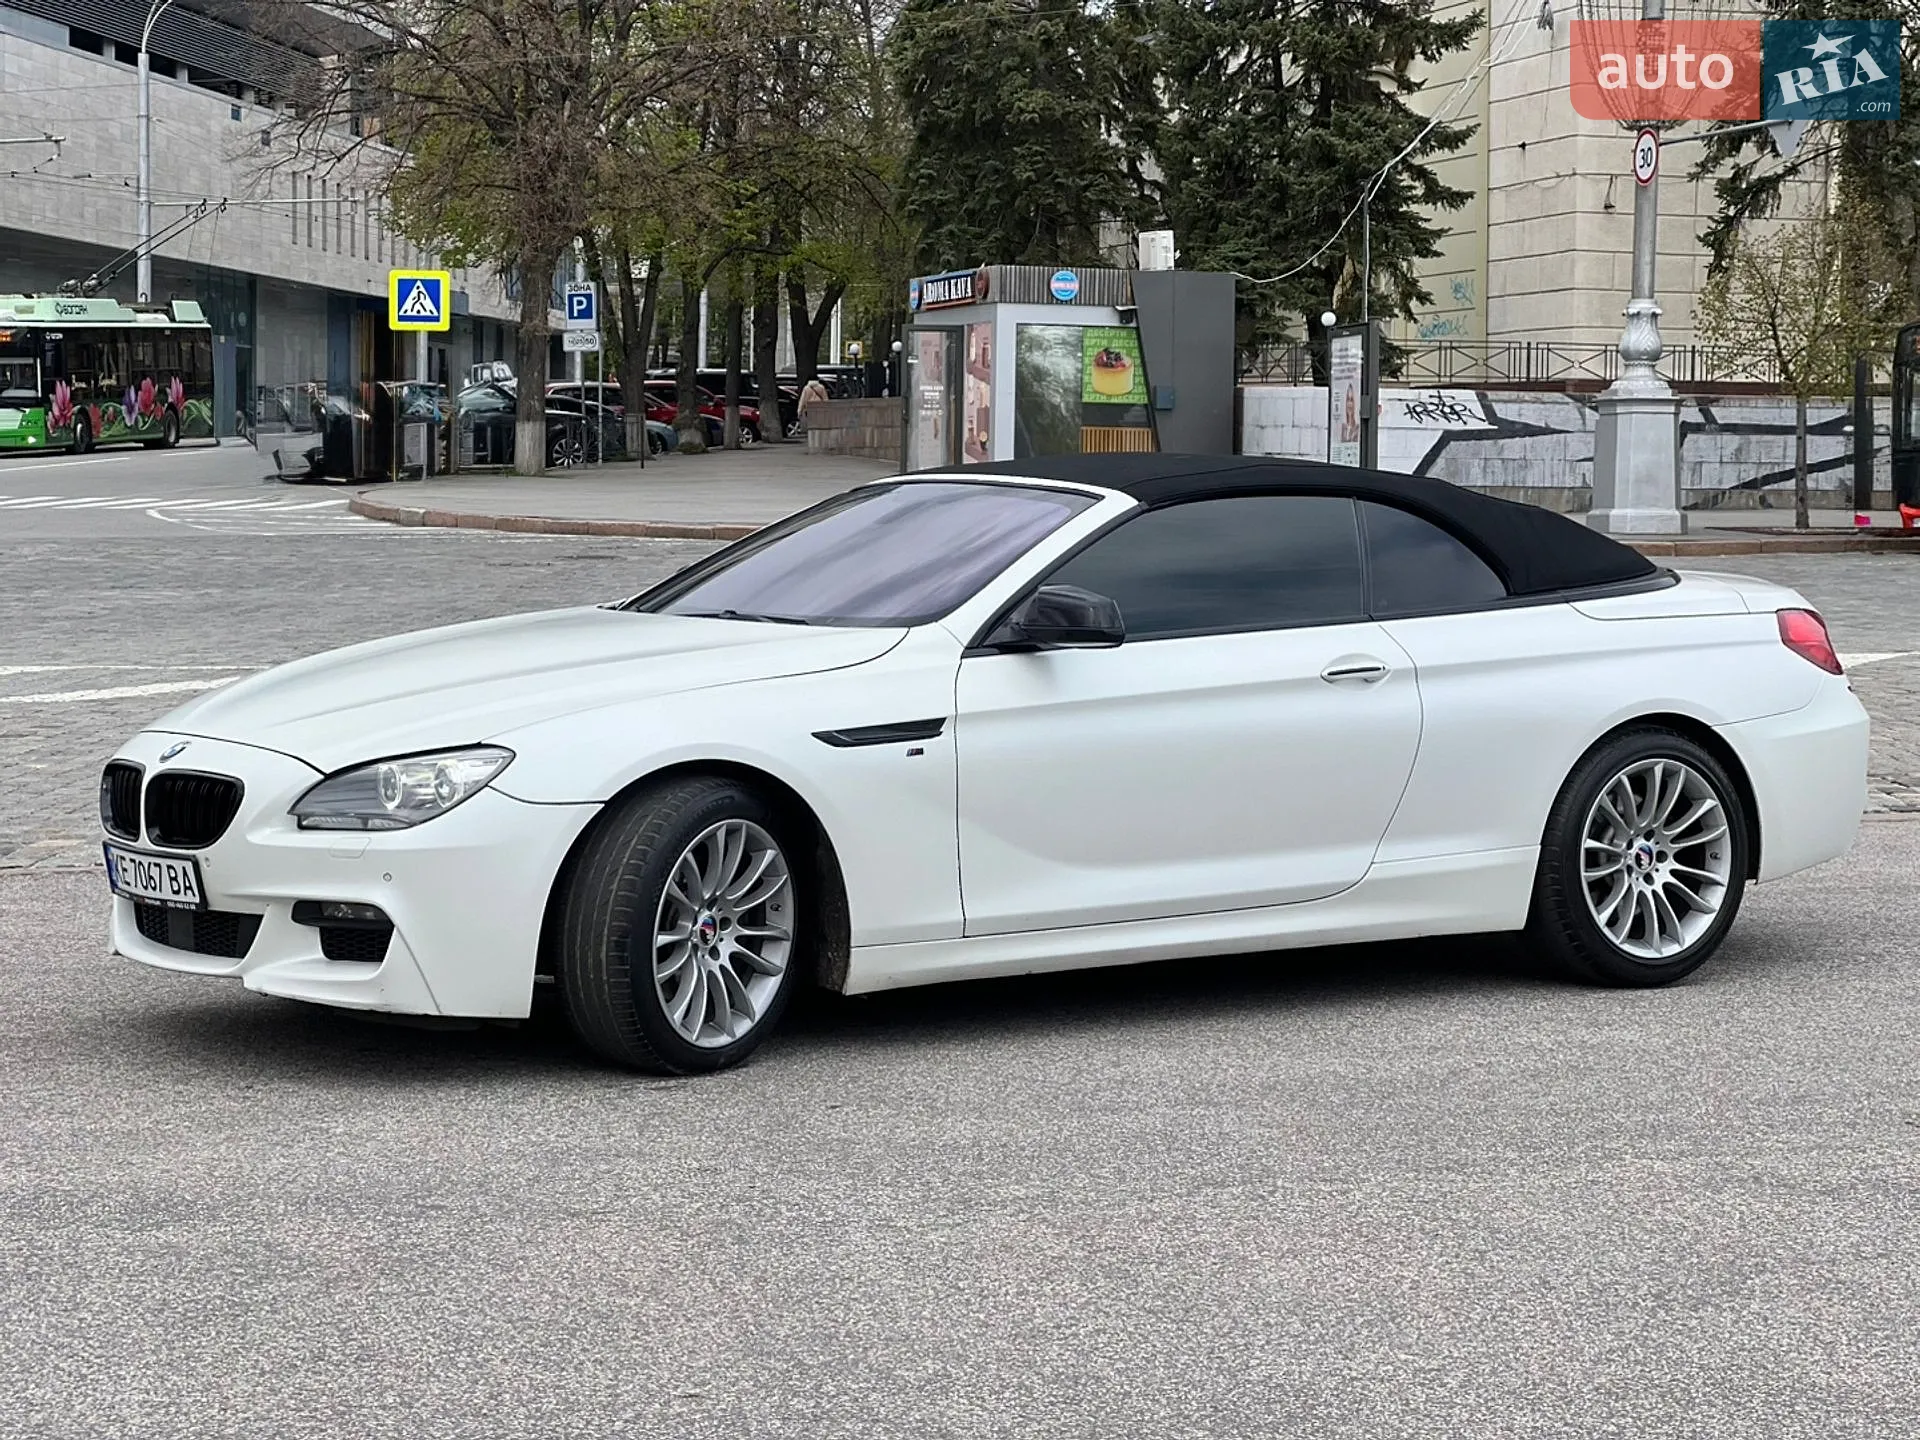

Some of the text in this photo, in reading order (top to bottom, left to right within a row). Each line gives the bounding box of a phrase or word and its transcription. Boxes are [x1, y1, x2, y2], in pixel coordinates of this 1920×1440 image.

[1639, 146, 1652, 169] 30
[568, 283, 592, 292] ЗОНА
[950, 275, 972, 300] KAVA
[573, 296, 588, 317] P
[129, 857, 162, 893] 7067
[166, 863, 196, 898] BA
